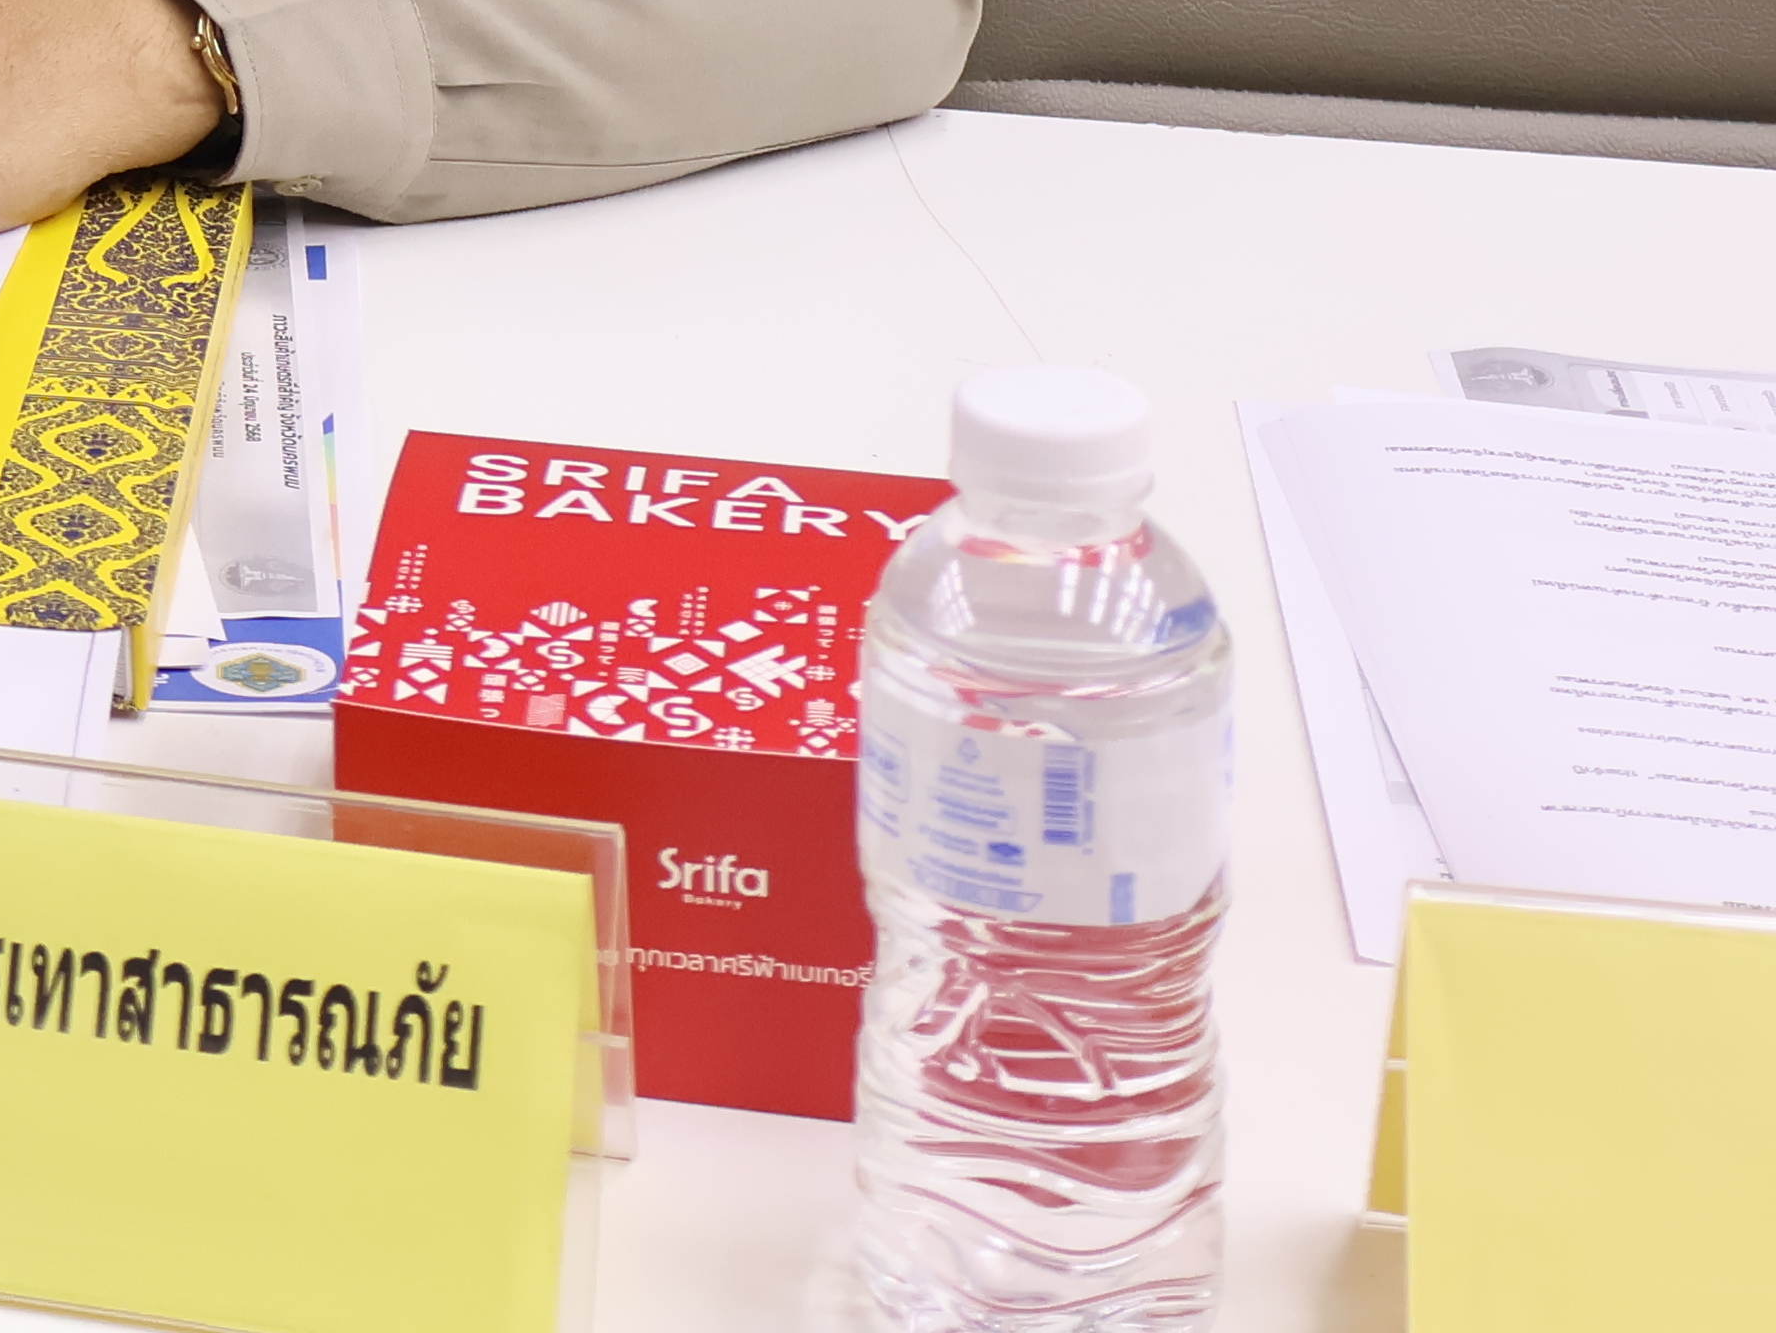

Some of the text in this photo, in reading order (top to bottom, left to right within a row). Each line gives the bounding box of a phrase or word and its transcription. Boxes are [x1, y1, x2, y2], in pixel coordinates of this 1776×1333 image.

[466, 454, 805, 504] SRIFA
[457, 482, 932, 541] BAKERY
[657, 846, 770, 898] Srifa
[682, 893, 743, 910] Bakery
